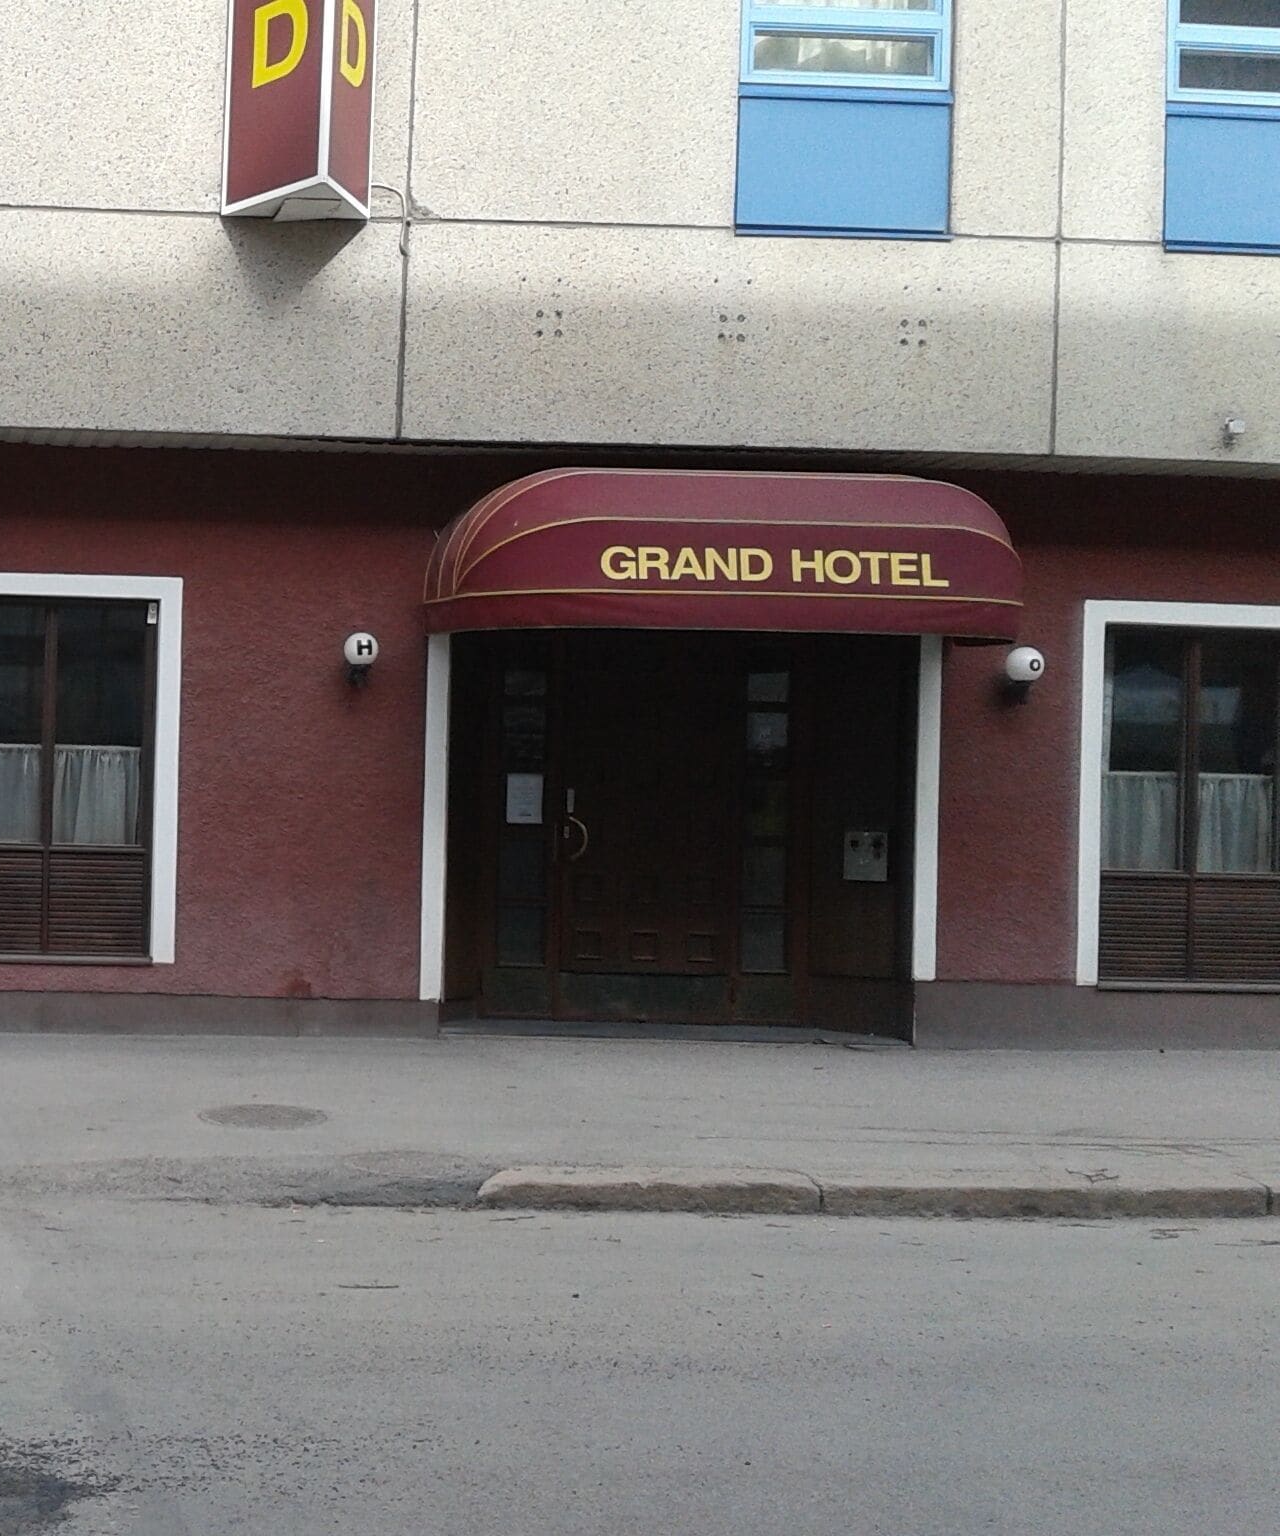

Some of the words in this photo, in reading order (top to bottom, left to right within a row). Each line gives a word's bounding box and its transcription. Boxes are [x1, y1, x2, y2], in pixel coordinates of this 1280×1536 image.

[252, 0, 308, 88] D
[600, 545, 773, 582] GRAND
[791, 549, 950, 588] HOTEL
[357, 639, 372, 656] H
